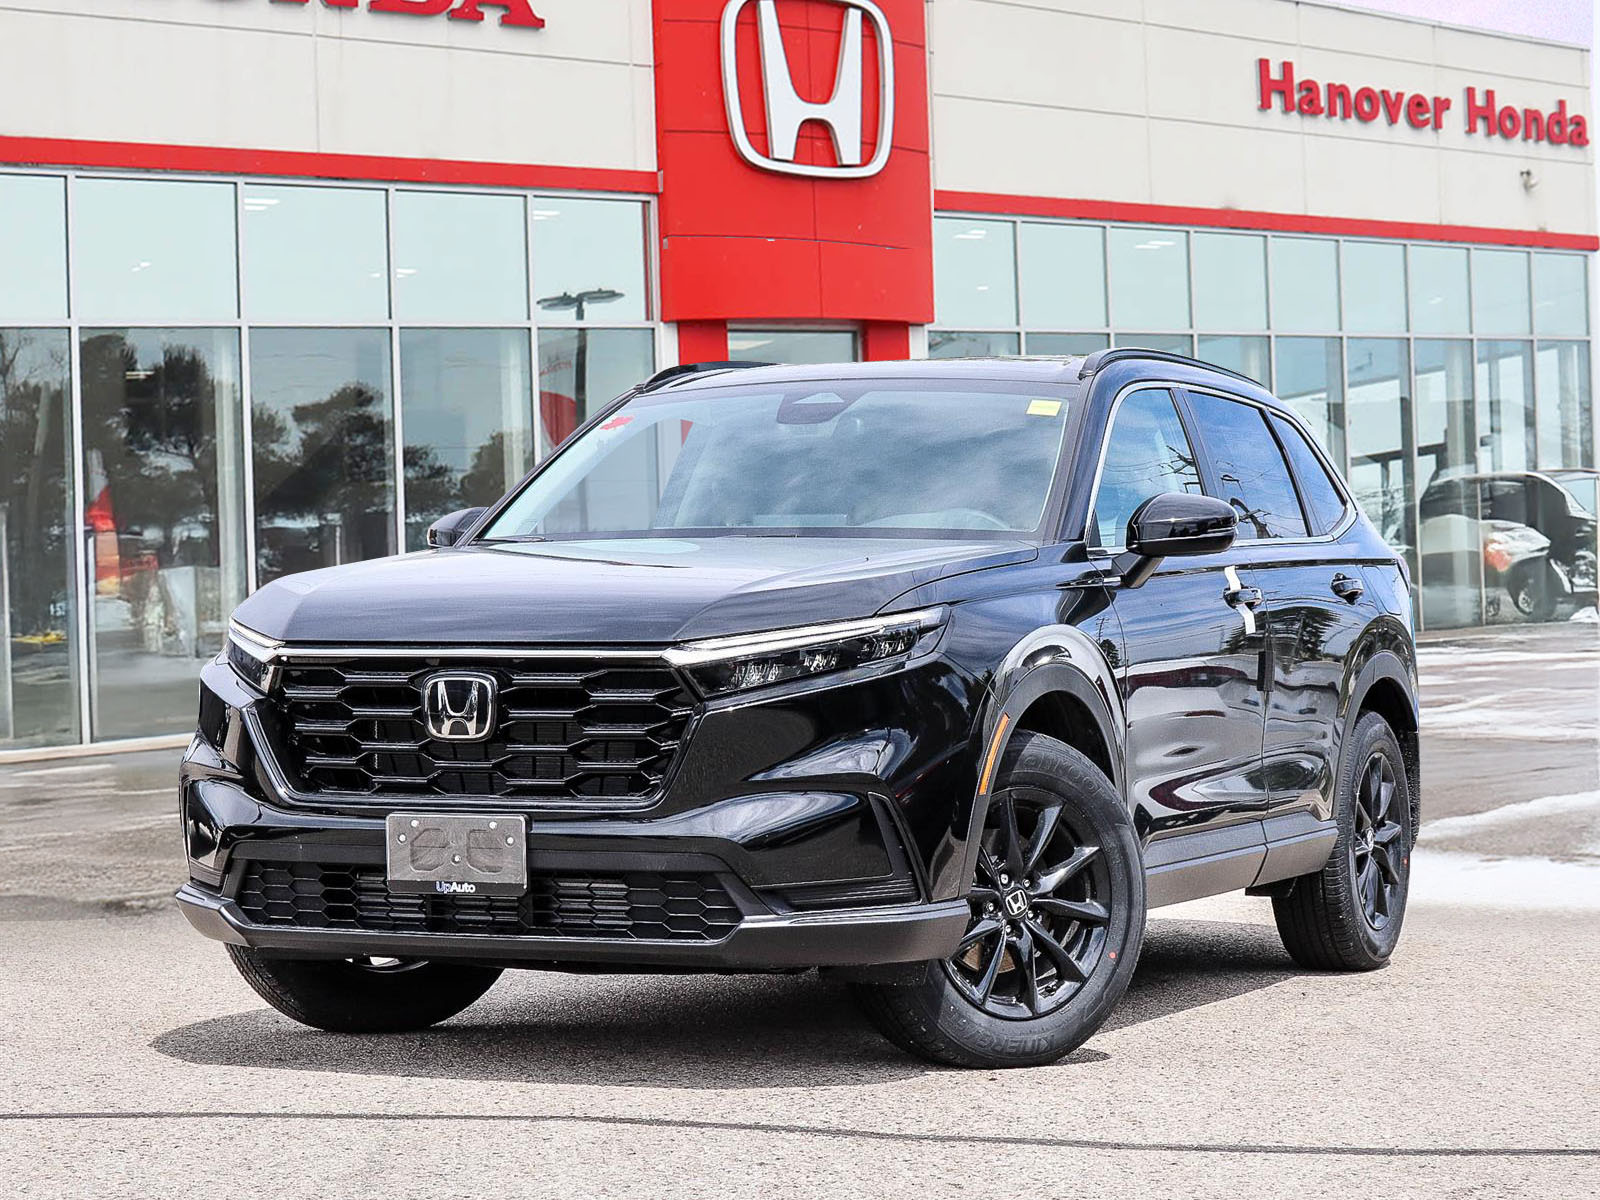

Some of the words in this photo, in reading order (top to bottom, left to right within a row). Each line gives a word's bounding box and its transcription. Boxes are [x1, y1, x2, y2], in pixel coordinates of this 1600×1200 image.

[1257, 58, 1451, 129] Hanover
[1465, 86, 1589, 147] Honda
[435, 880, 476, 894] UpAuto
